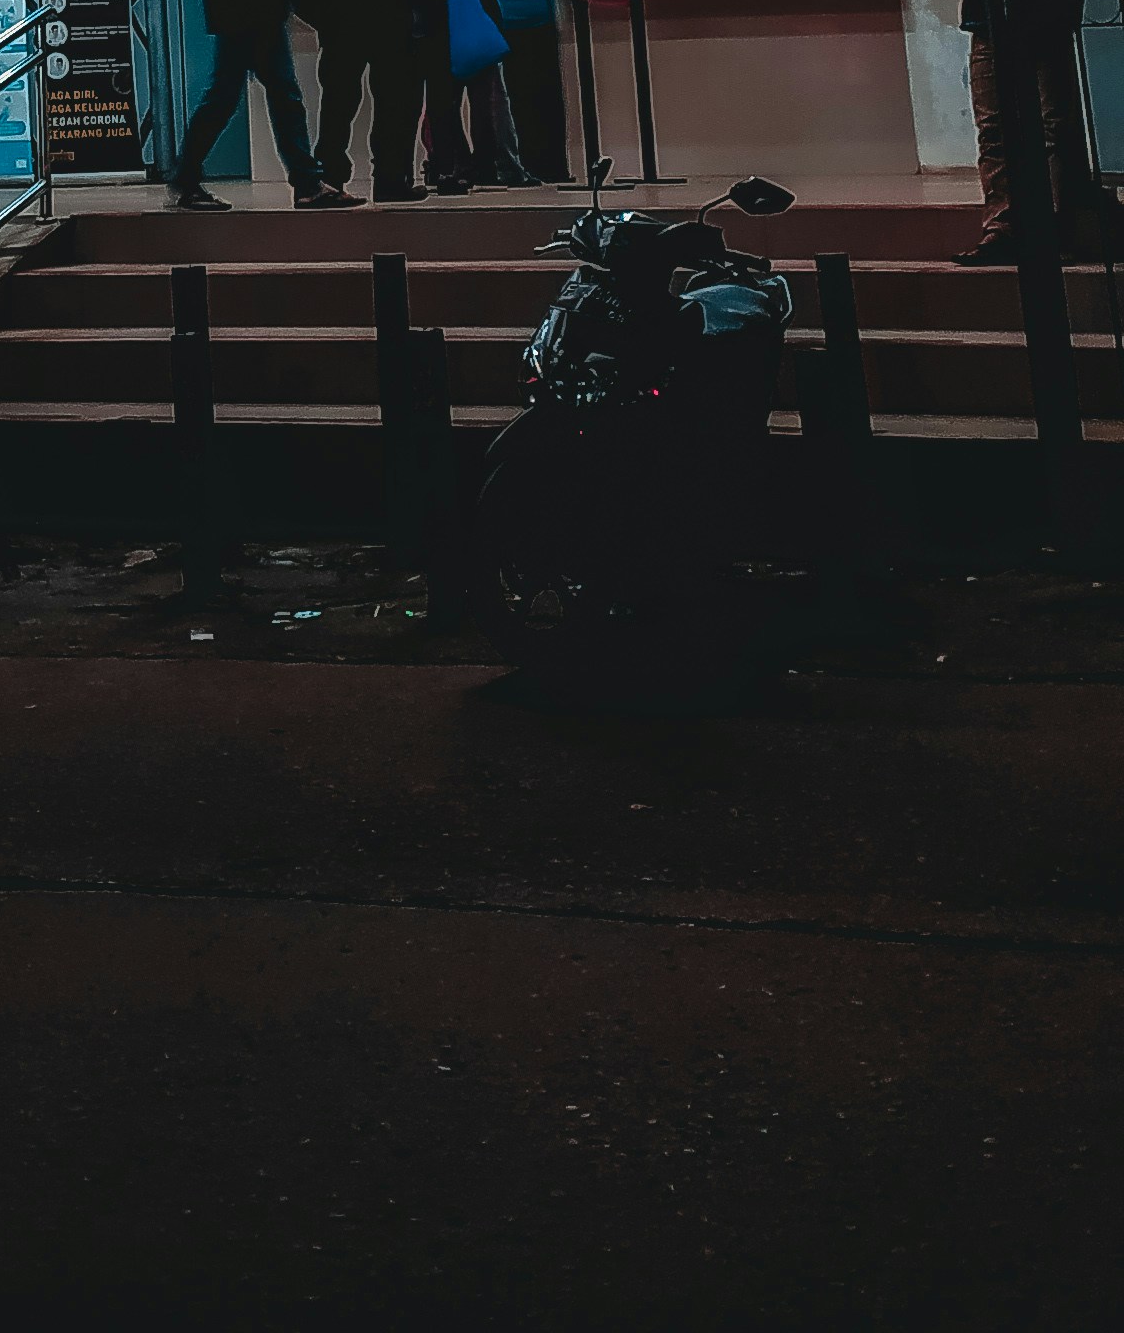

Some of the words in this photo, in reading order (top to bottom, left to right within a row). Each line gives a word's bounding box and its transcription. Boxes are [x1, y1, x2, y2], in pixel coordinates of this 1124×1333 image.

[74, 101, 130, 113] KELUARGA
[83, 114, 127, 126] CORONA
[106, 127, 133, 138] JUGA
